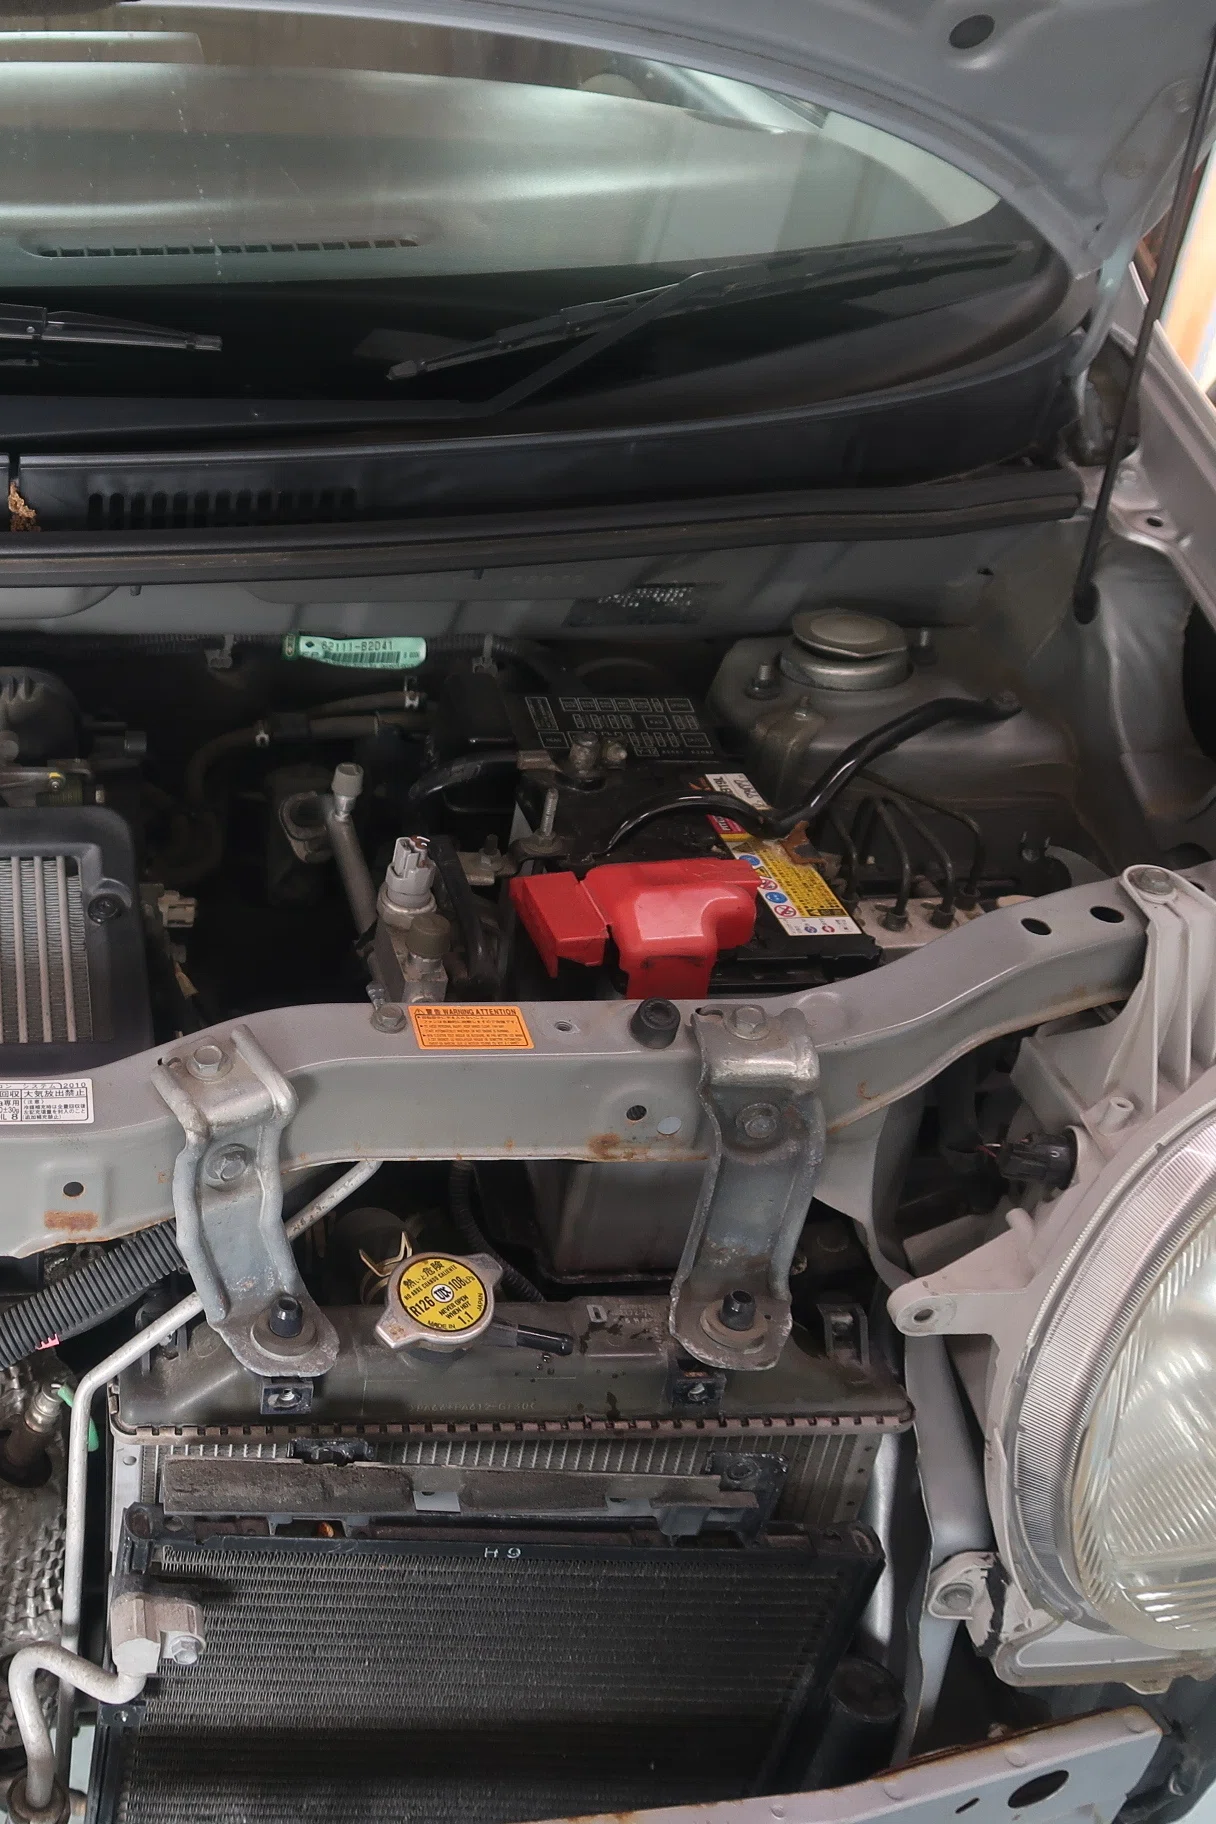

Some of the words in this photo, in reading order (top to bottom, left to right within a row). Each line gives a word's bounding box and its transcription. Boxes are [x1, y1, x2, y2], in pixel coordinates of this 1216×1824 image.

[24, 1089, 85, 1098] 大気放出禁止
[403, 1261, 445, 1289] 熱いと危険
[409, 1296, 435, 1318] R126
[439, 1301, 455, 1316] NEVER
[455, 1294, 469, 1306] OPEN
[445, 1307, 461, 1320] WHEN
[460, 1301, 472, 1312] HOT
[427, 1320, 447, 1330] MADE
[458, 1311, 474, 1325] 1.1
